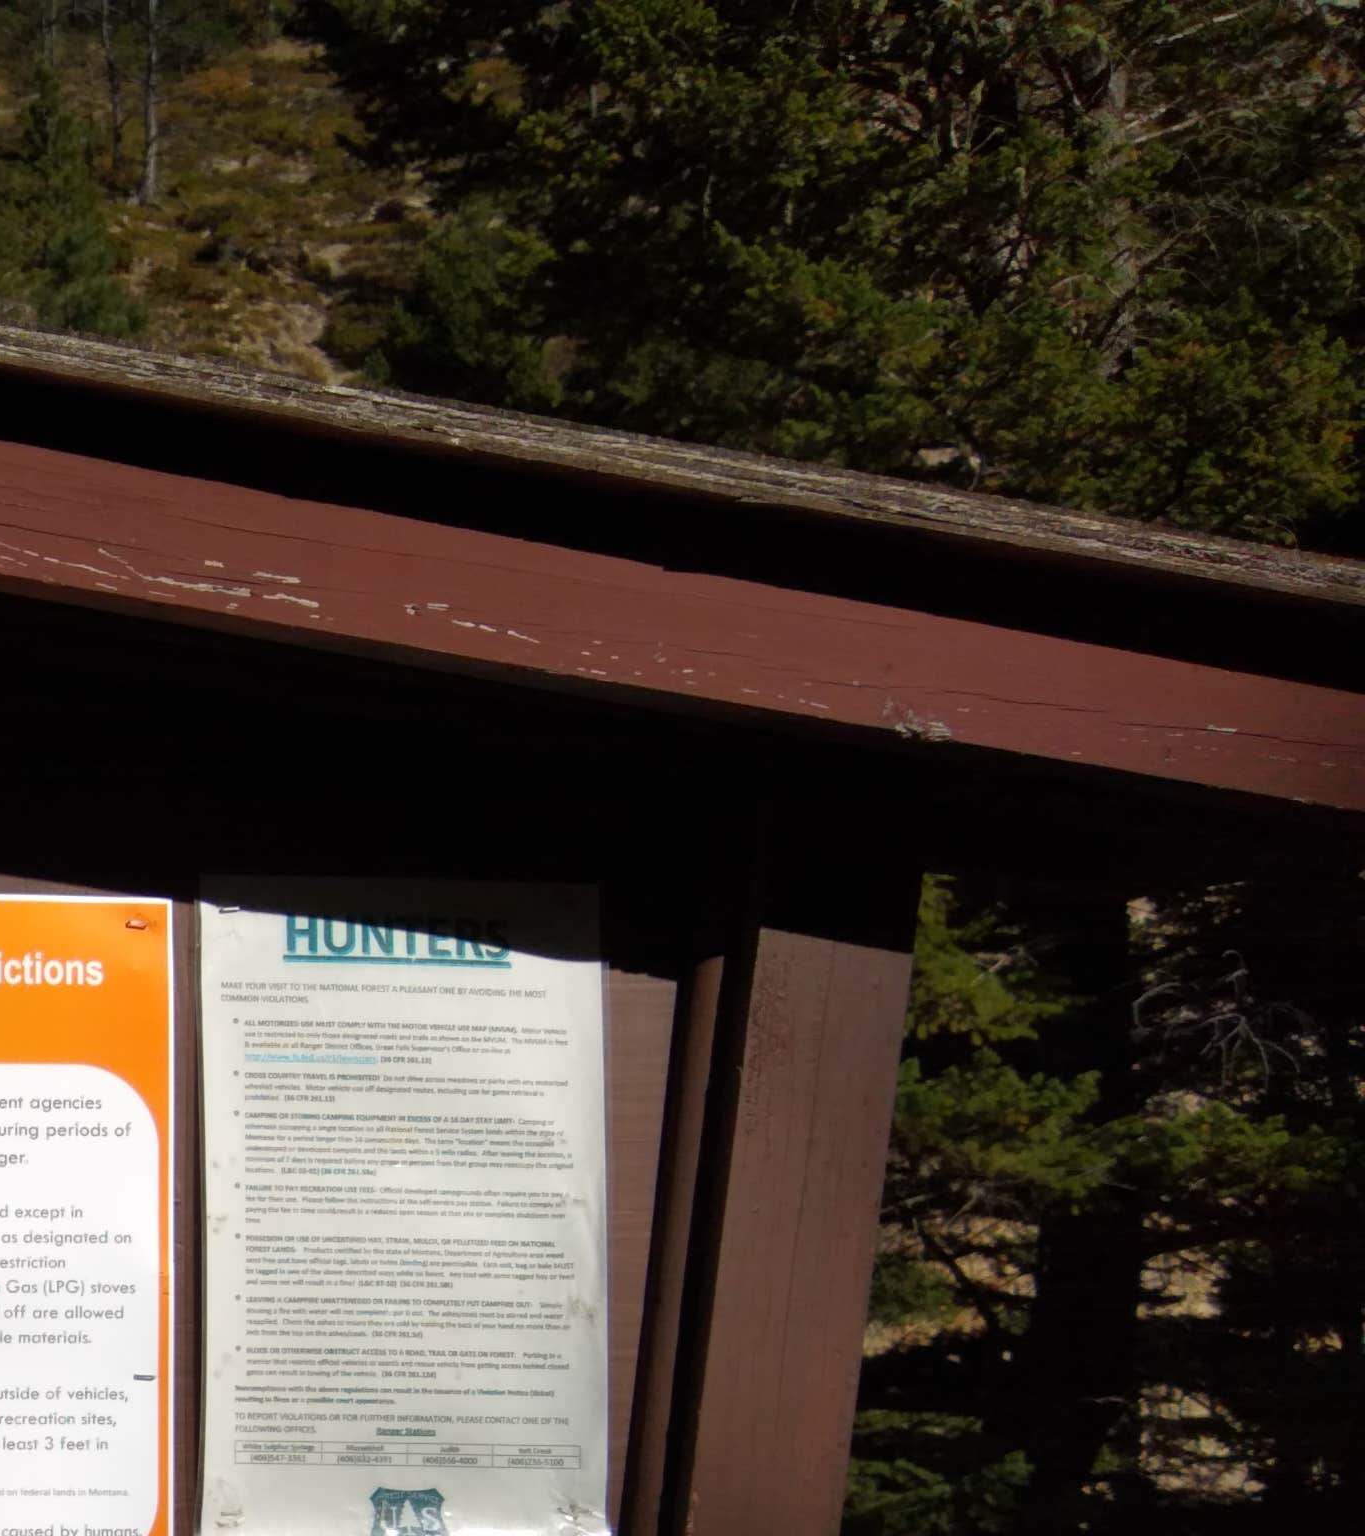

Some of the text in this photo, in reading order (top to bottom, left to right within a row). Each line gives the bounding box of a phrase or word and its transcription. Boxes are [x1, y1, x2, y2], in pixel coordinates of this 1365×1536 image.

[286, 913, 510, 960] HUNTERS
[30, 1099, 102, 1112] agencies
[46, 1123, 108, 1140] periods
[115, 1122, 131, 1137] of
[15, 1206, 65, 1221] except
[71, 1205, 83, 1219] in
[46, 1387, 60, 1399] of
[68, 1388, 128, 1402] vehicles,
